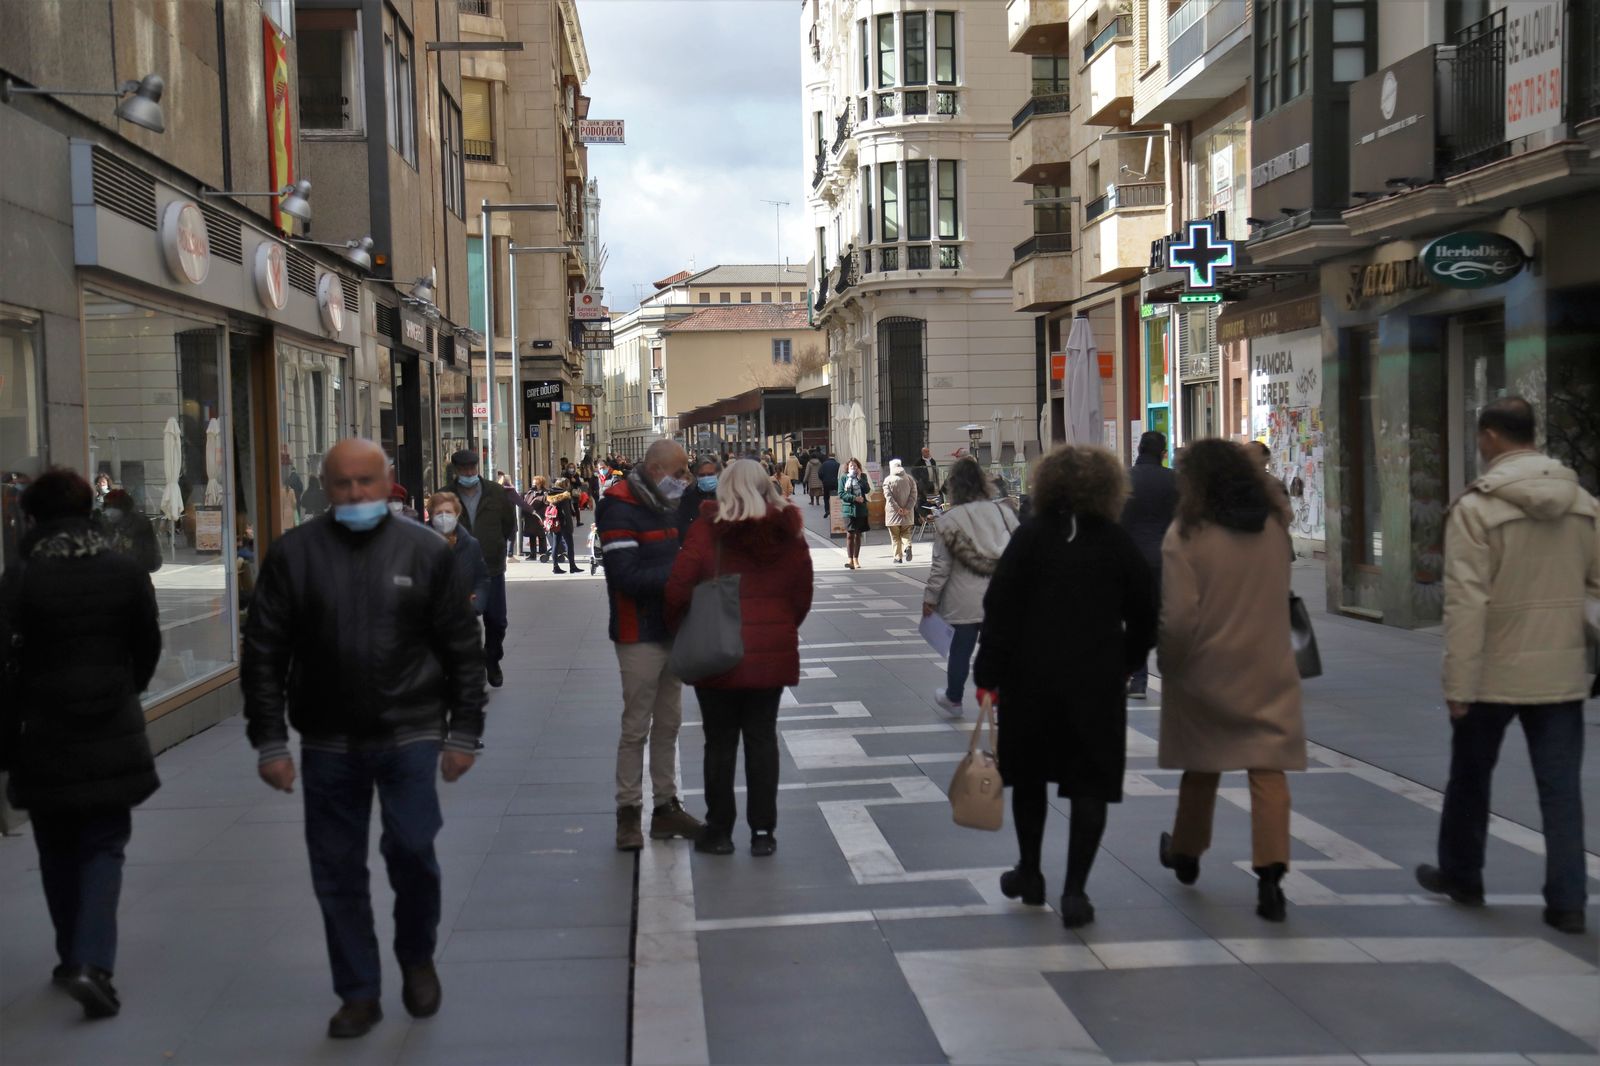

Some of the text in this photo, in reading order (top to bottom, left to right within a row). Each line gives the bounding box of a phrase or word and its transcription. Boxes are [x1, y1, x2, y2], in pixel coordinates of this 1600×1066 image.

[1508, 2, 1560, 65] SE ALQUILA
[580, 126, 623, 136] PODOLOGO
[1256, 350, 1294, 377] ZAMORA
[1256, 382, 1278, 406] LIBRE
[1278, 381, 1289, 404] DE
